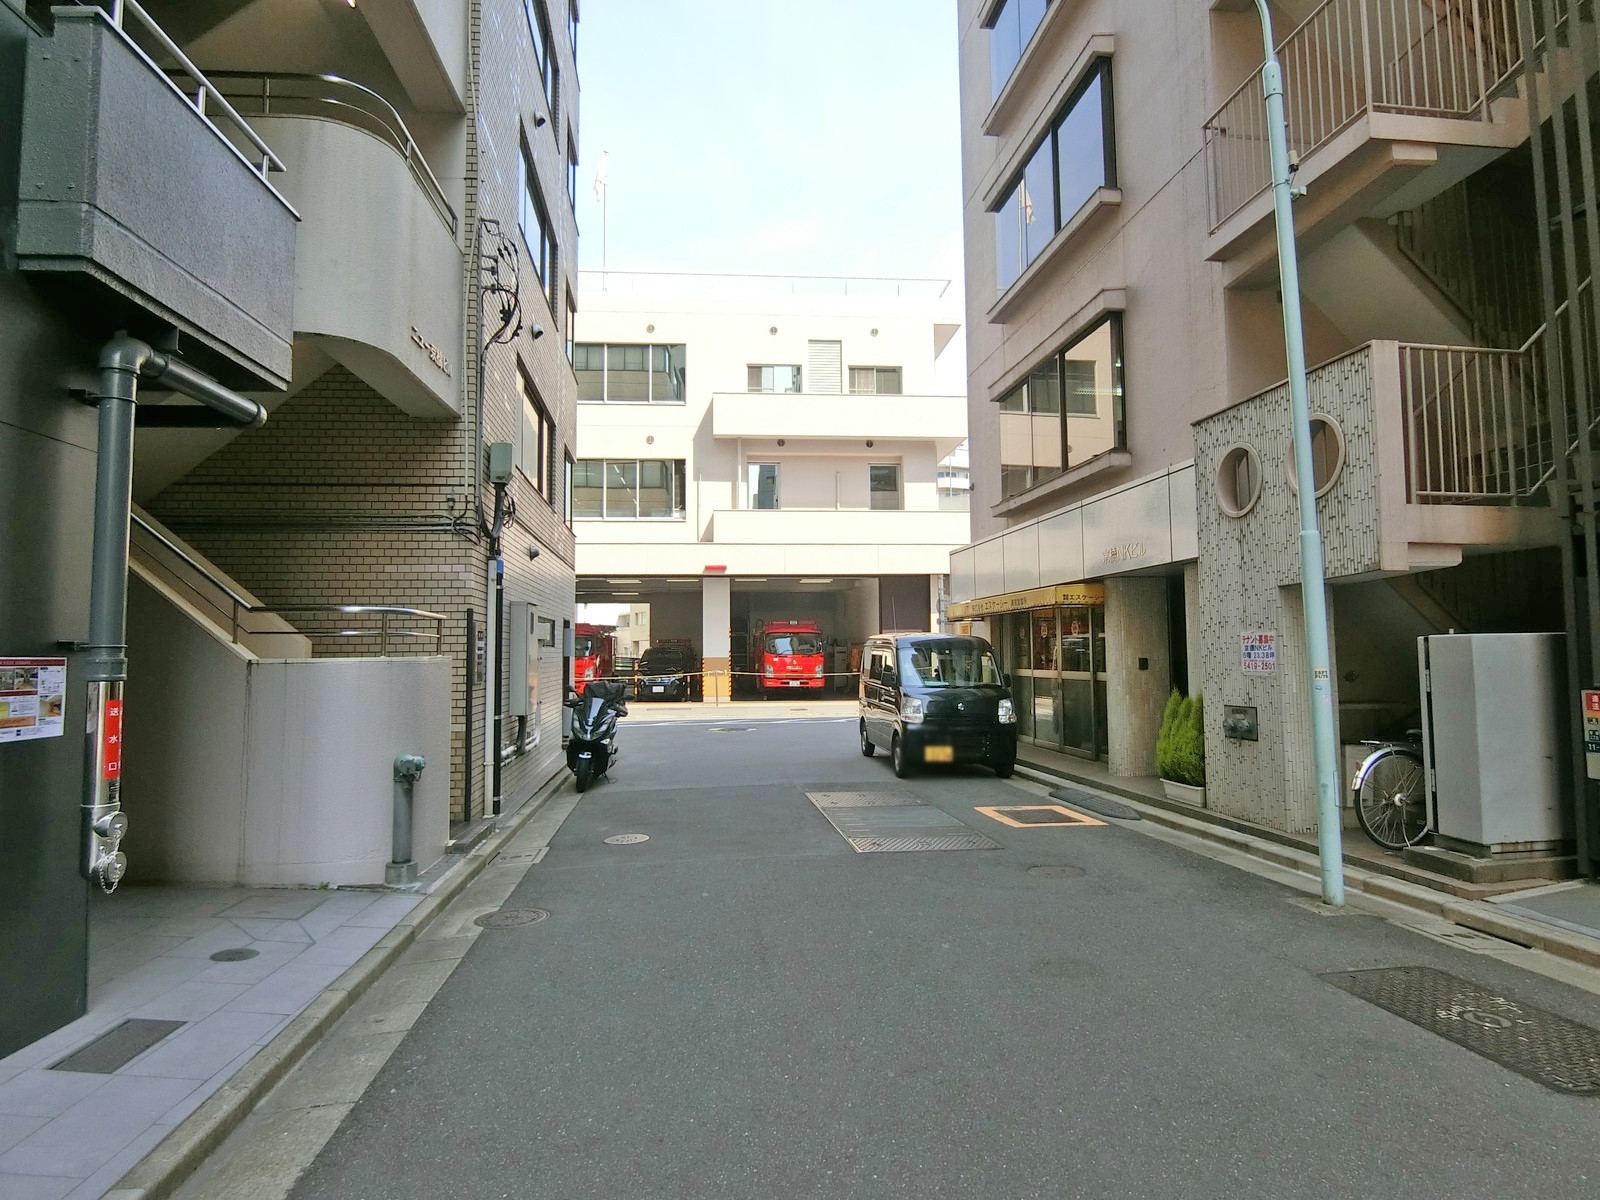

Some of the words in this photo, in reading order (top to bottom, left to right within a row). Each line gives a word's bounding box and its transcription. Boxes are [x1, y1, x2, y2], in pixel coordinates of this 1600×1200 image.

[1242, 634, 1275, 644] テナント募集中
[108, 706, 119, 771] 送水口
